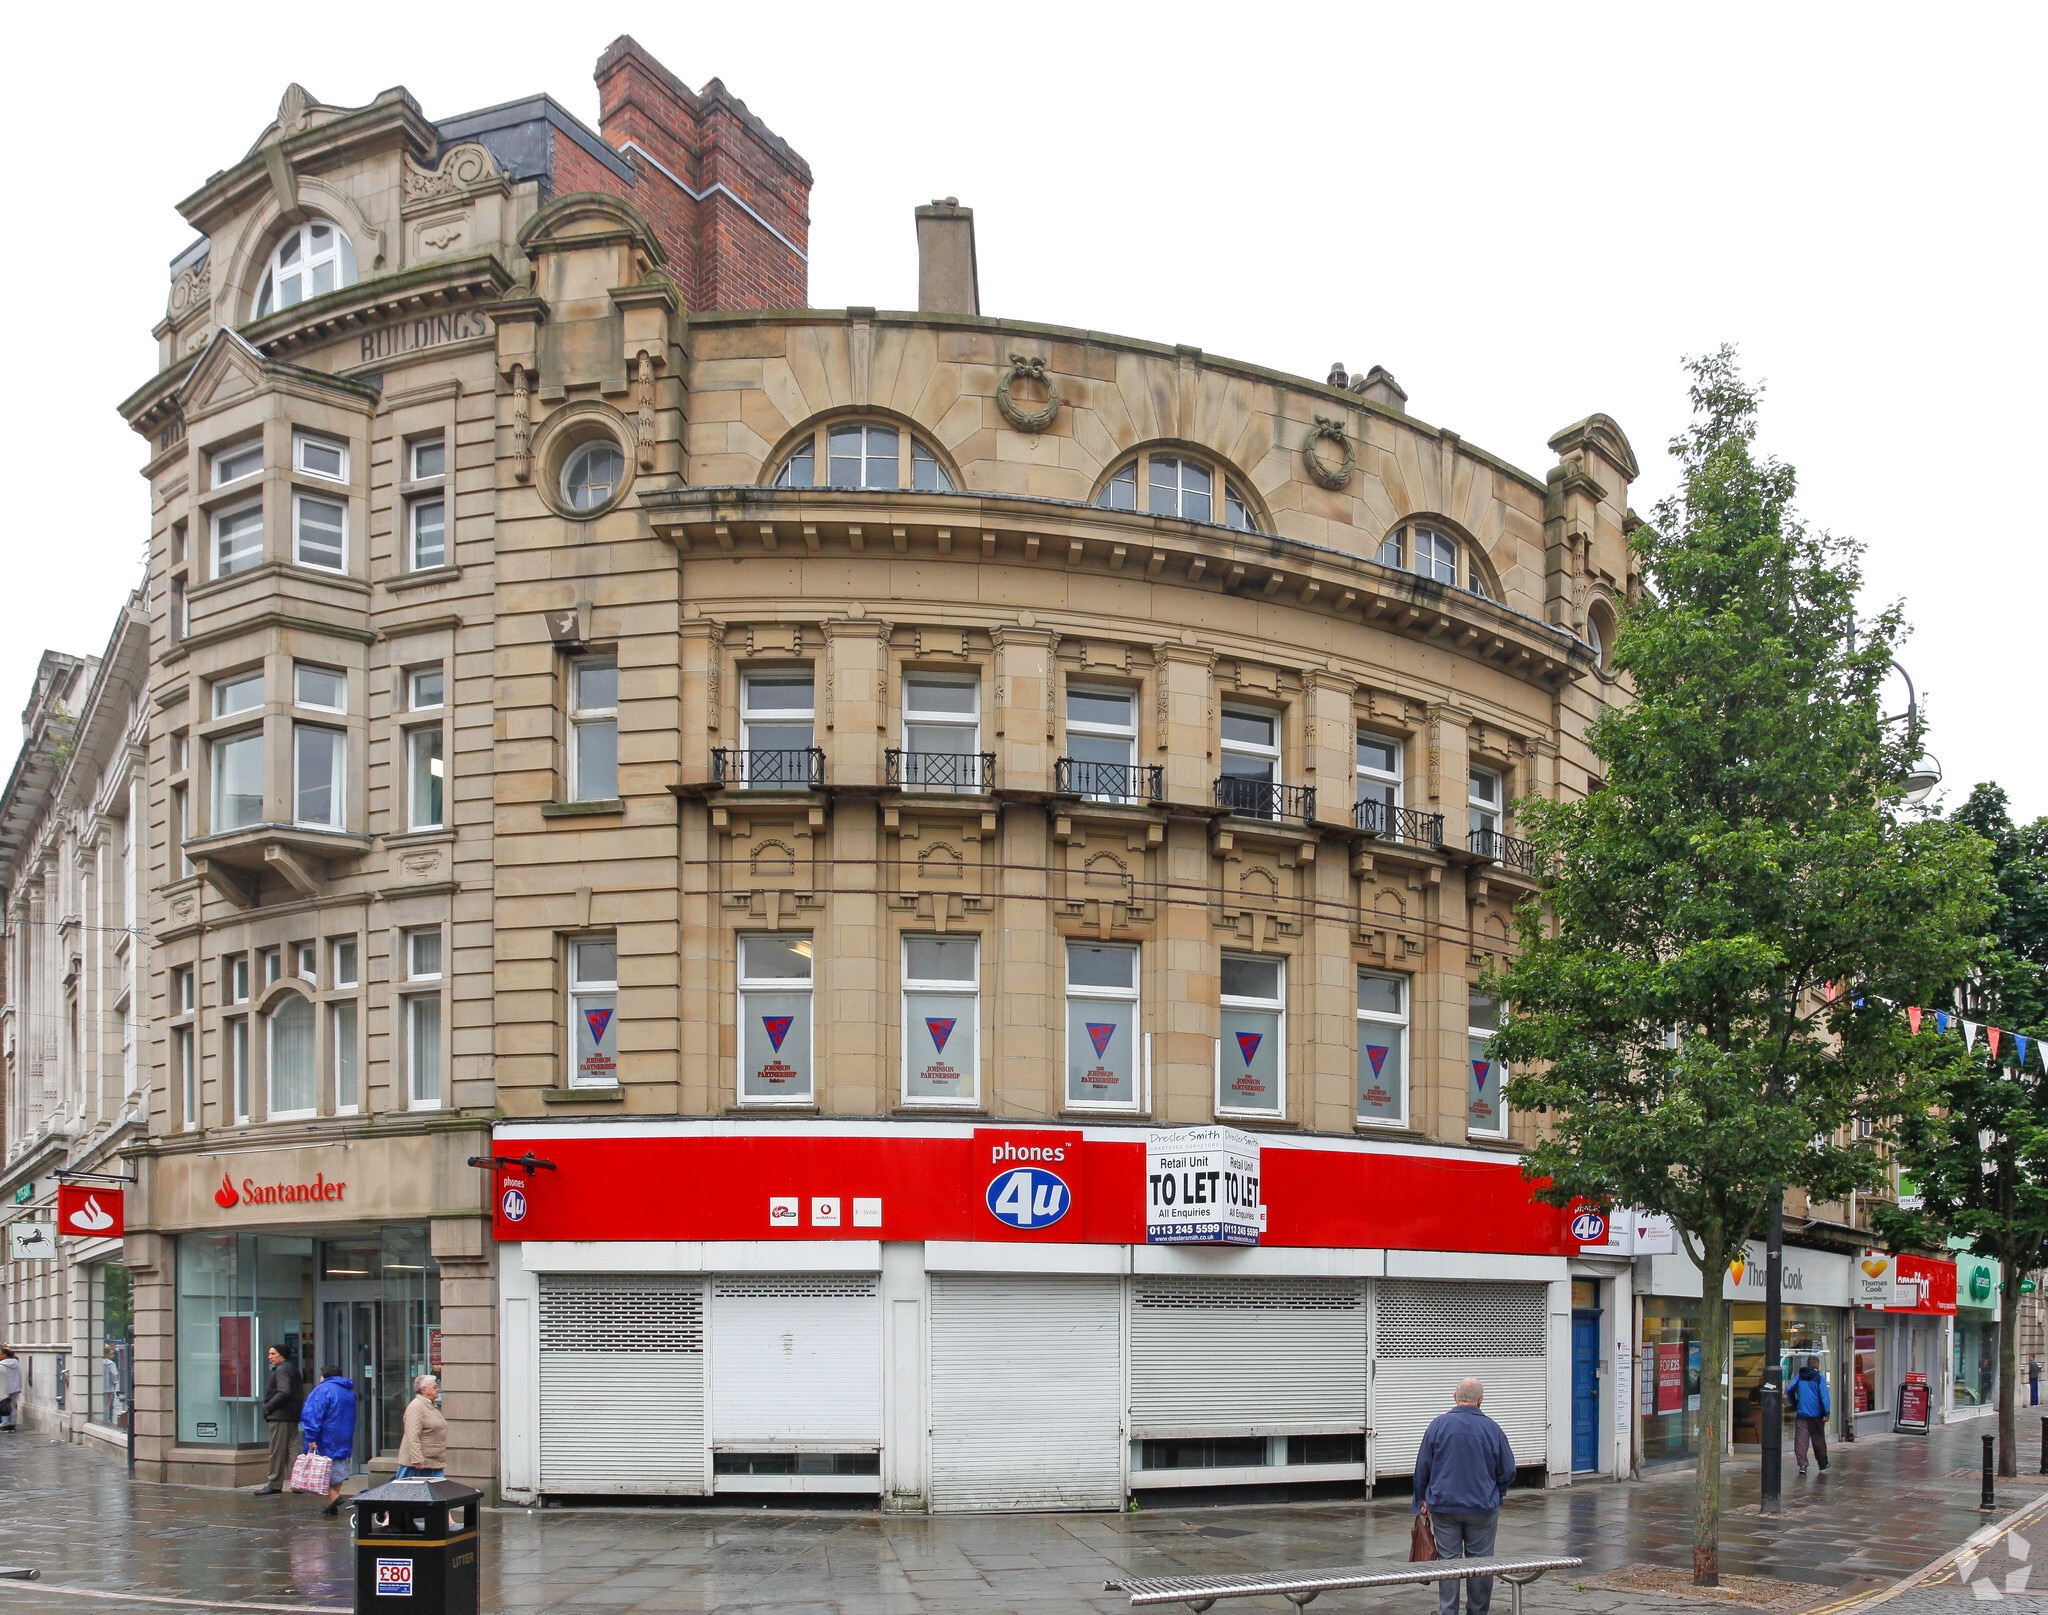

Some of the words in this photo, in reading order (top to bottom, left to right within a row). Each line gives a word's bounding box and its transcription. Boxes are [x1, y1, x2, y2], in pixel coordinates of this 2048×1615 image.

[361, 307, 486, 362] BUILDINGS
[1081, 1076, 1119, 1084] PARTNERSHIP
[1231, 1084, 1266, 1092] PARTNERSHIP
[1150, 1132, 1188, 1143] Dresler
[1188, 1130, 1220, 1141] Smith
[992, 1141, 1065, 1164] phones
[1160, 1157, 1187, 1169] Retail
[1189, 1156, 1209, 1168] Unit
[1230, 1157, 1243, 1169] Retail
[1244, 1161, 1254, 1172] Unit
[242, 1171, 346, 1205] Santander
[503, 1176, 525, 1188] phones
[1149, 1173, 1176, 1206] TO
[1183, 1171, 1220, 1204] LET
[1224, 1171, 1238, 1205] TO
[1241, 1175, 1259, 1208] LET
[505, 1191, 524, 1219] 4u
[995, 1171, 1063, 1225] 4u
[1159, 1209, 1170, 1218] All
[1171, 1208, 1211, 1219] Enquiries
[1236, 1209, 1254, 1220] Enquiries
[1149, 1226, 1173, 1235] 0113
[1175, 1225, 1193, 1234] 245
[1196, 1224, 1220, 1233] 5599
[1224, 1225, 1237, 1234] 0113
[1237, 1227, 1247, 1236] 245
[1246, 1228, 1259, 1237] 5599
[1574, 1216, 1601, 1239] 4u
[1155, 1234, 1214, 1242] www.dreslersmith.co.uk
[1782, 1266, 1803, 1291] Cook
[452, 1551, 474, 1569] LITTER
[380, 1566, 411, 1582] £80
